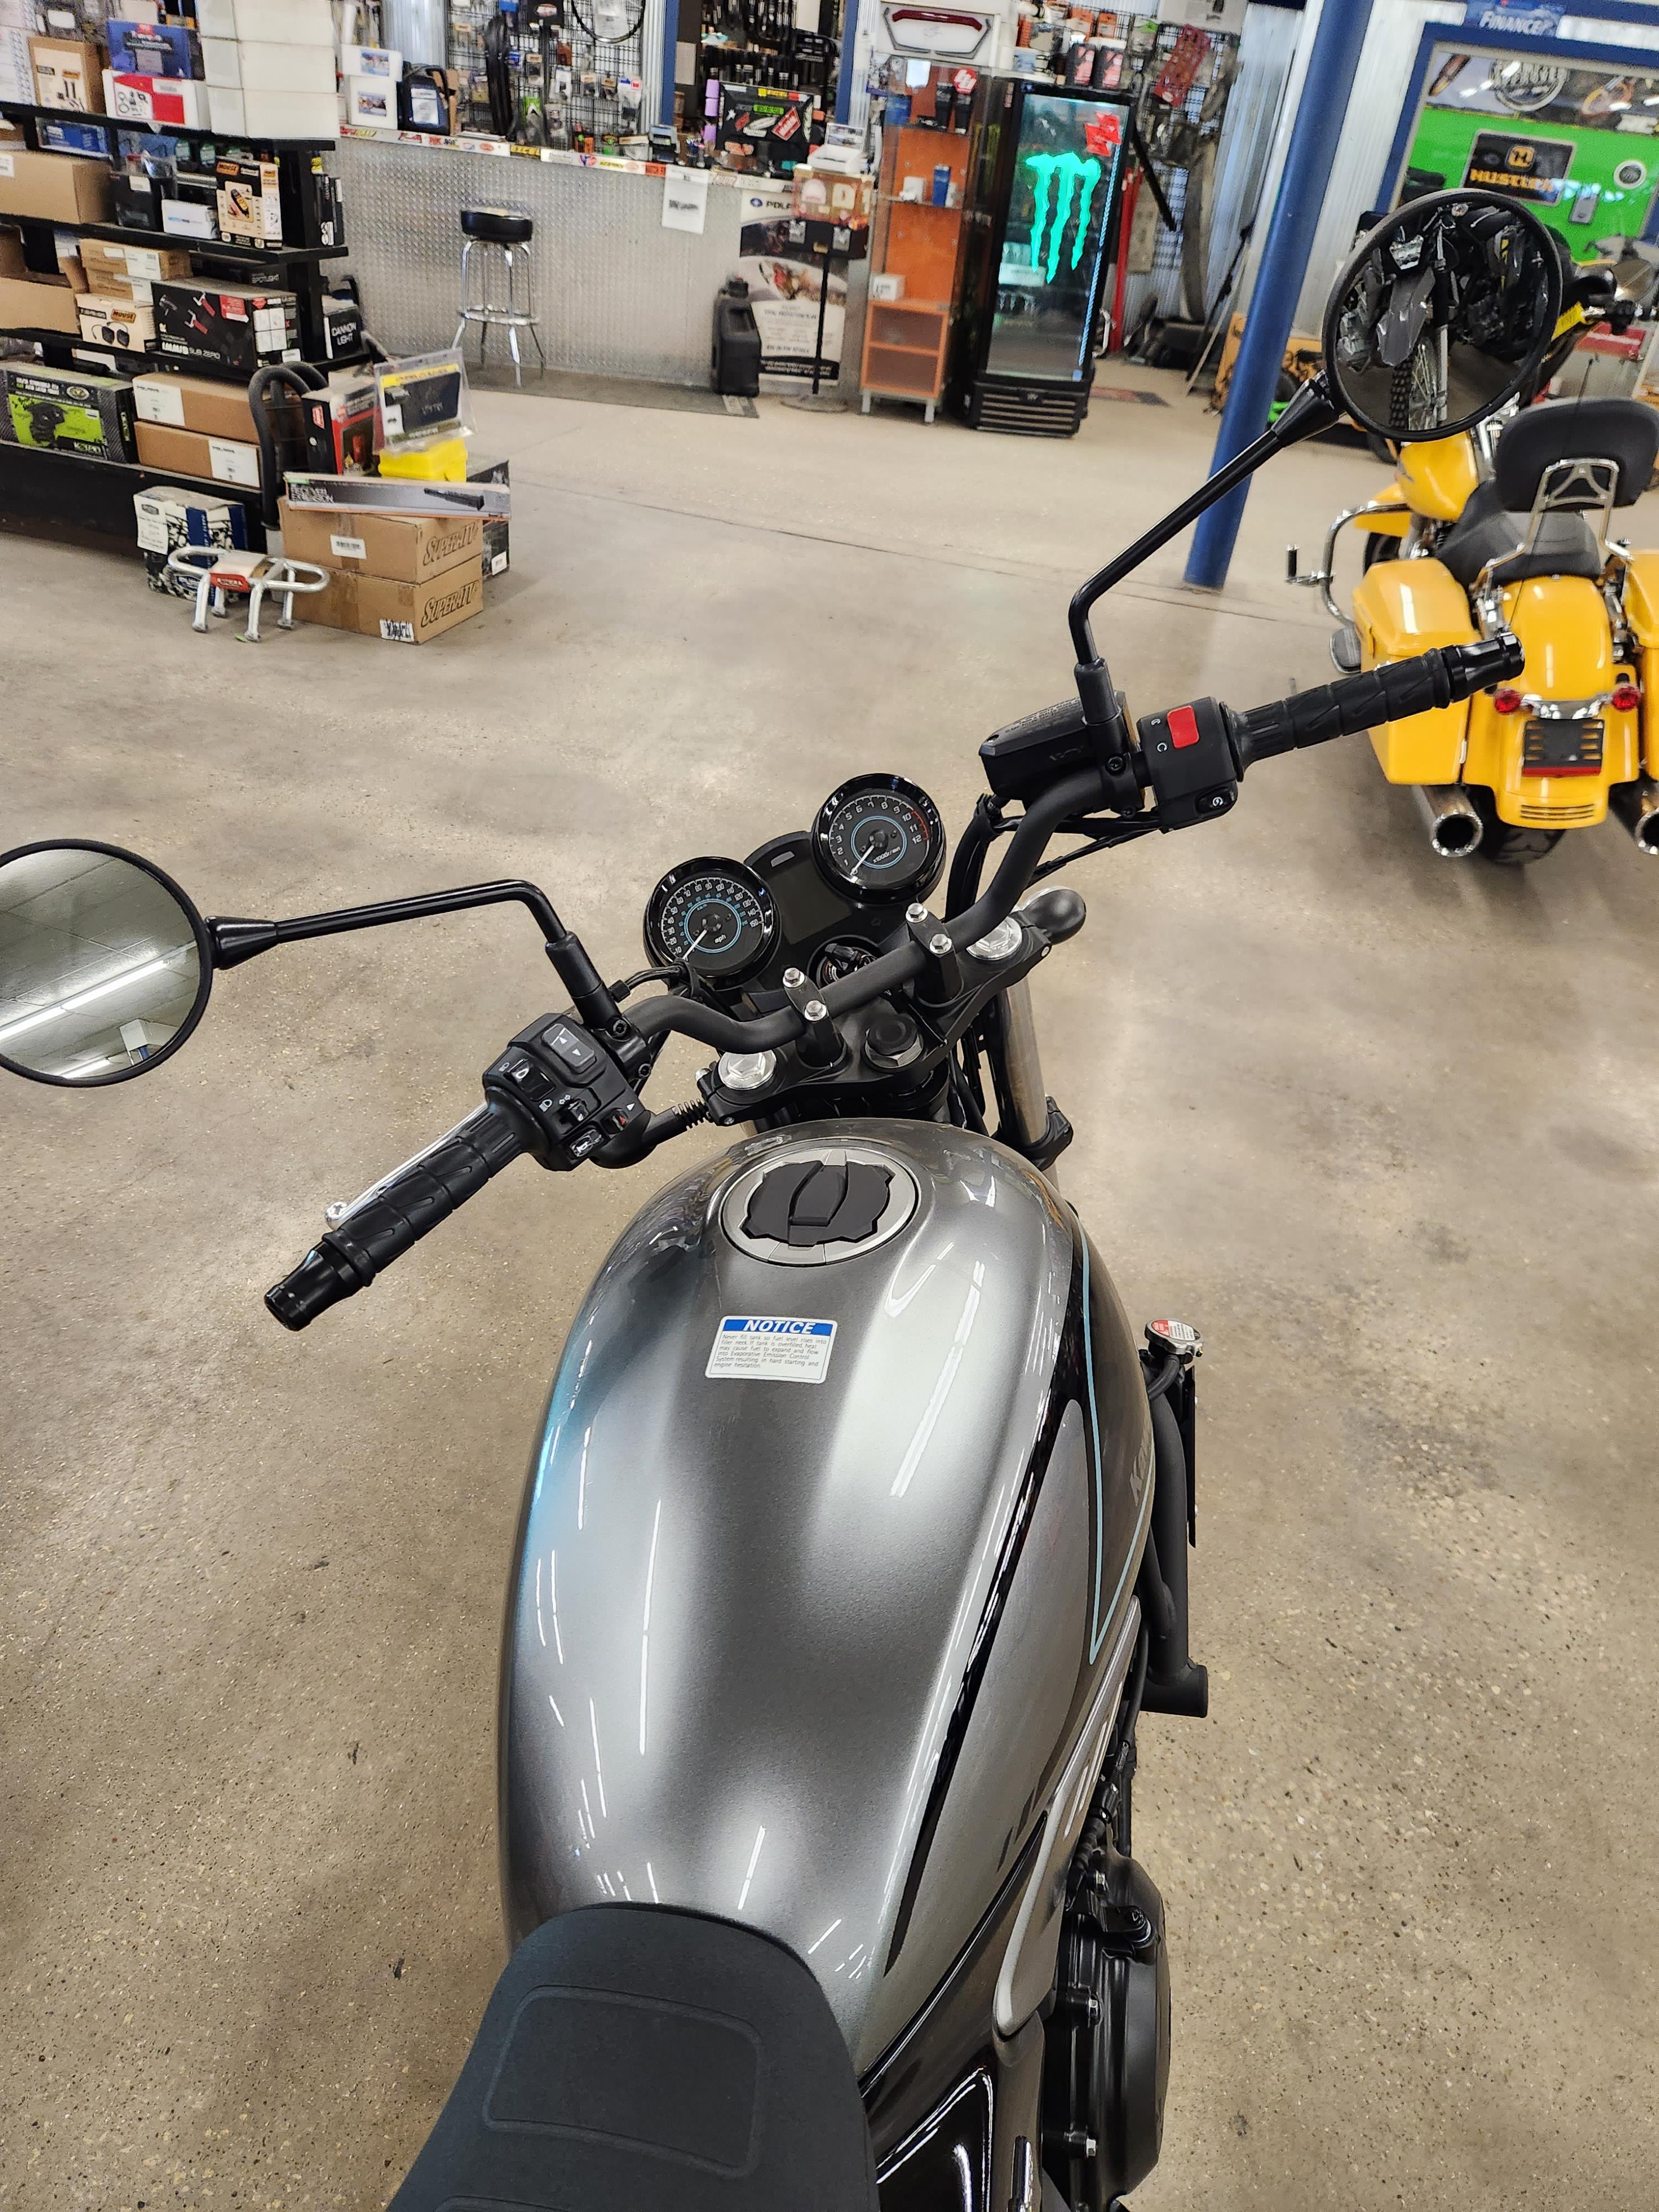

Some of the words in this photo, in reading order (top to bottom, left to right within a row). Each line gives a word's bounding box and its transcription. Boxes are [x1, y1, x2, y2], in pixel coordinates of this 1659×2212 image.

[855, 805, 863, 813] 6
[881, 801, 888, 810] 8
[893, 806, 900, 814] 9
[845, 812, 853, 821] 5
[902, 812, 912, 822] 10
[909, 823, 918, 833] 11
[835, 835, 842, 844] 3
[912, 834, 922, 844] 12
[837, 847, 844, 855] 2
[695, 883, 702, 892] 80
[705, 882, 713, 890] 90
[716, 883, 725, 891] 100
[726, 886, 735, 895] 110
[684, 889, 691, 898] 70
[734, 893, 743, 901] 120
[676, 896, 684, 905] 60
[742, 899, 752, 908] 130
[670, 906, 678, 915] 50
[747, 908, 757, 917] 140
[749, 919, 759, 928] 150
[667, 927, 675, 935] 30
[669, 937, 677, 945] 20
[743, 1319, 816, 1334] NOTICE
